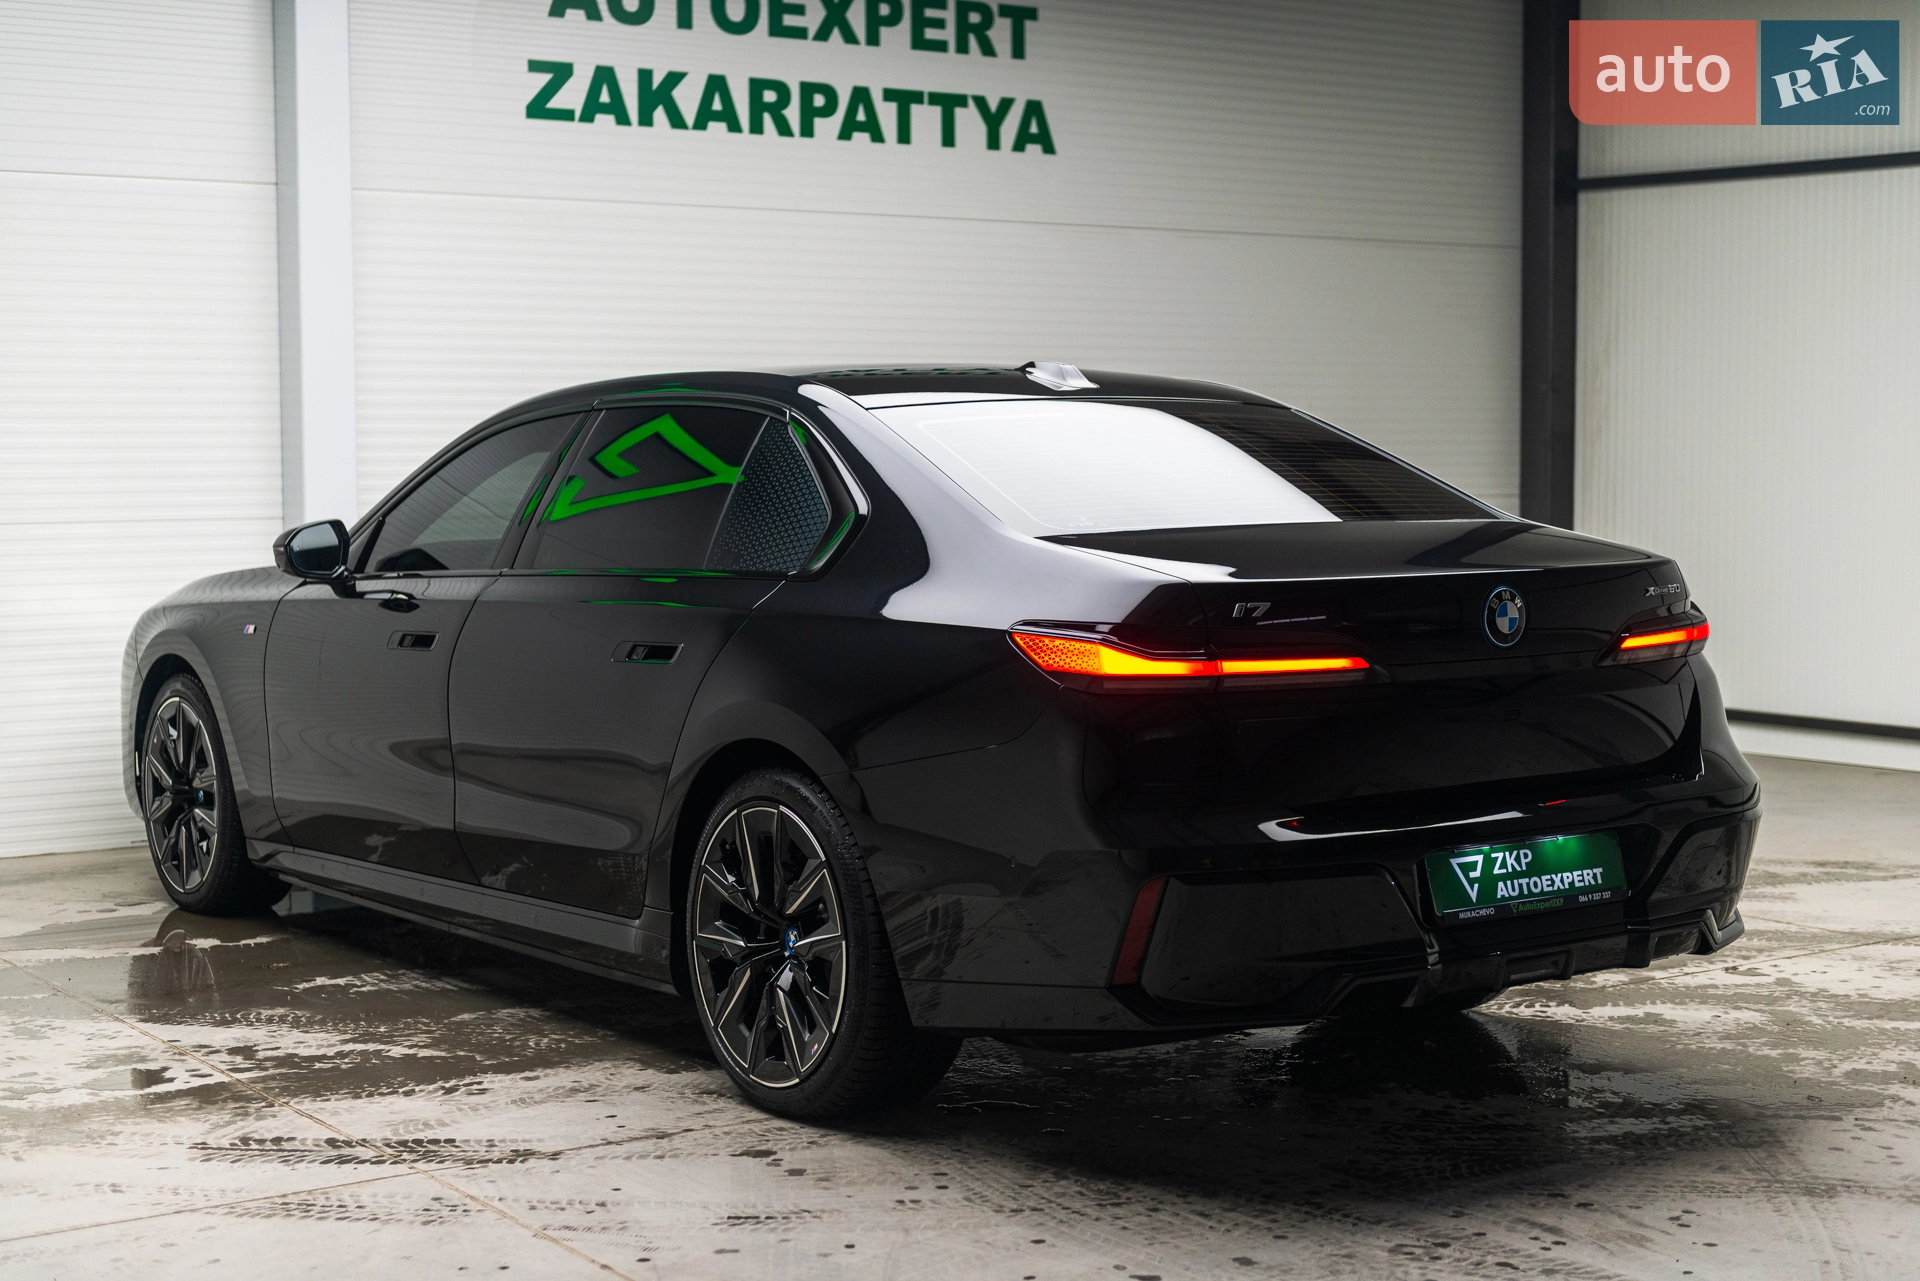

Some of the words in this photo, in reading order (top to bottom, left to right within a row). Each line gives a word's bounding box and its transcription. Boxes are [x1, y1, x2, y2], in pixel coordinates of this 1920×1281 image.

[525, 59, 1057, 155] ZAKARPATTYA
[1232, 602, 1271, 618] i7
[1490, 590, 1522, 609] BMW
[1490, 848, 1533, 874] ZKP
[1496, 867, 1603, 899] AUTOEXPERT
[1458, 907, 1495, 920] MUKACHEVO
